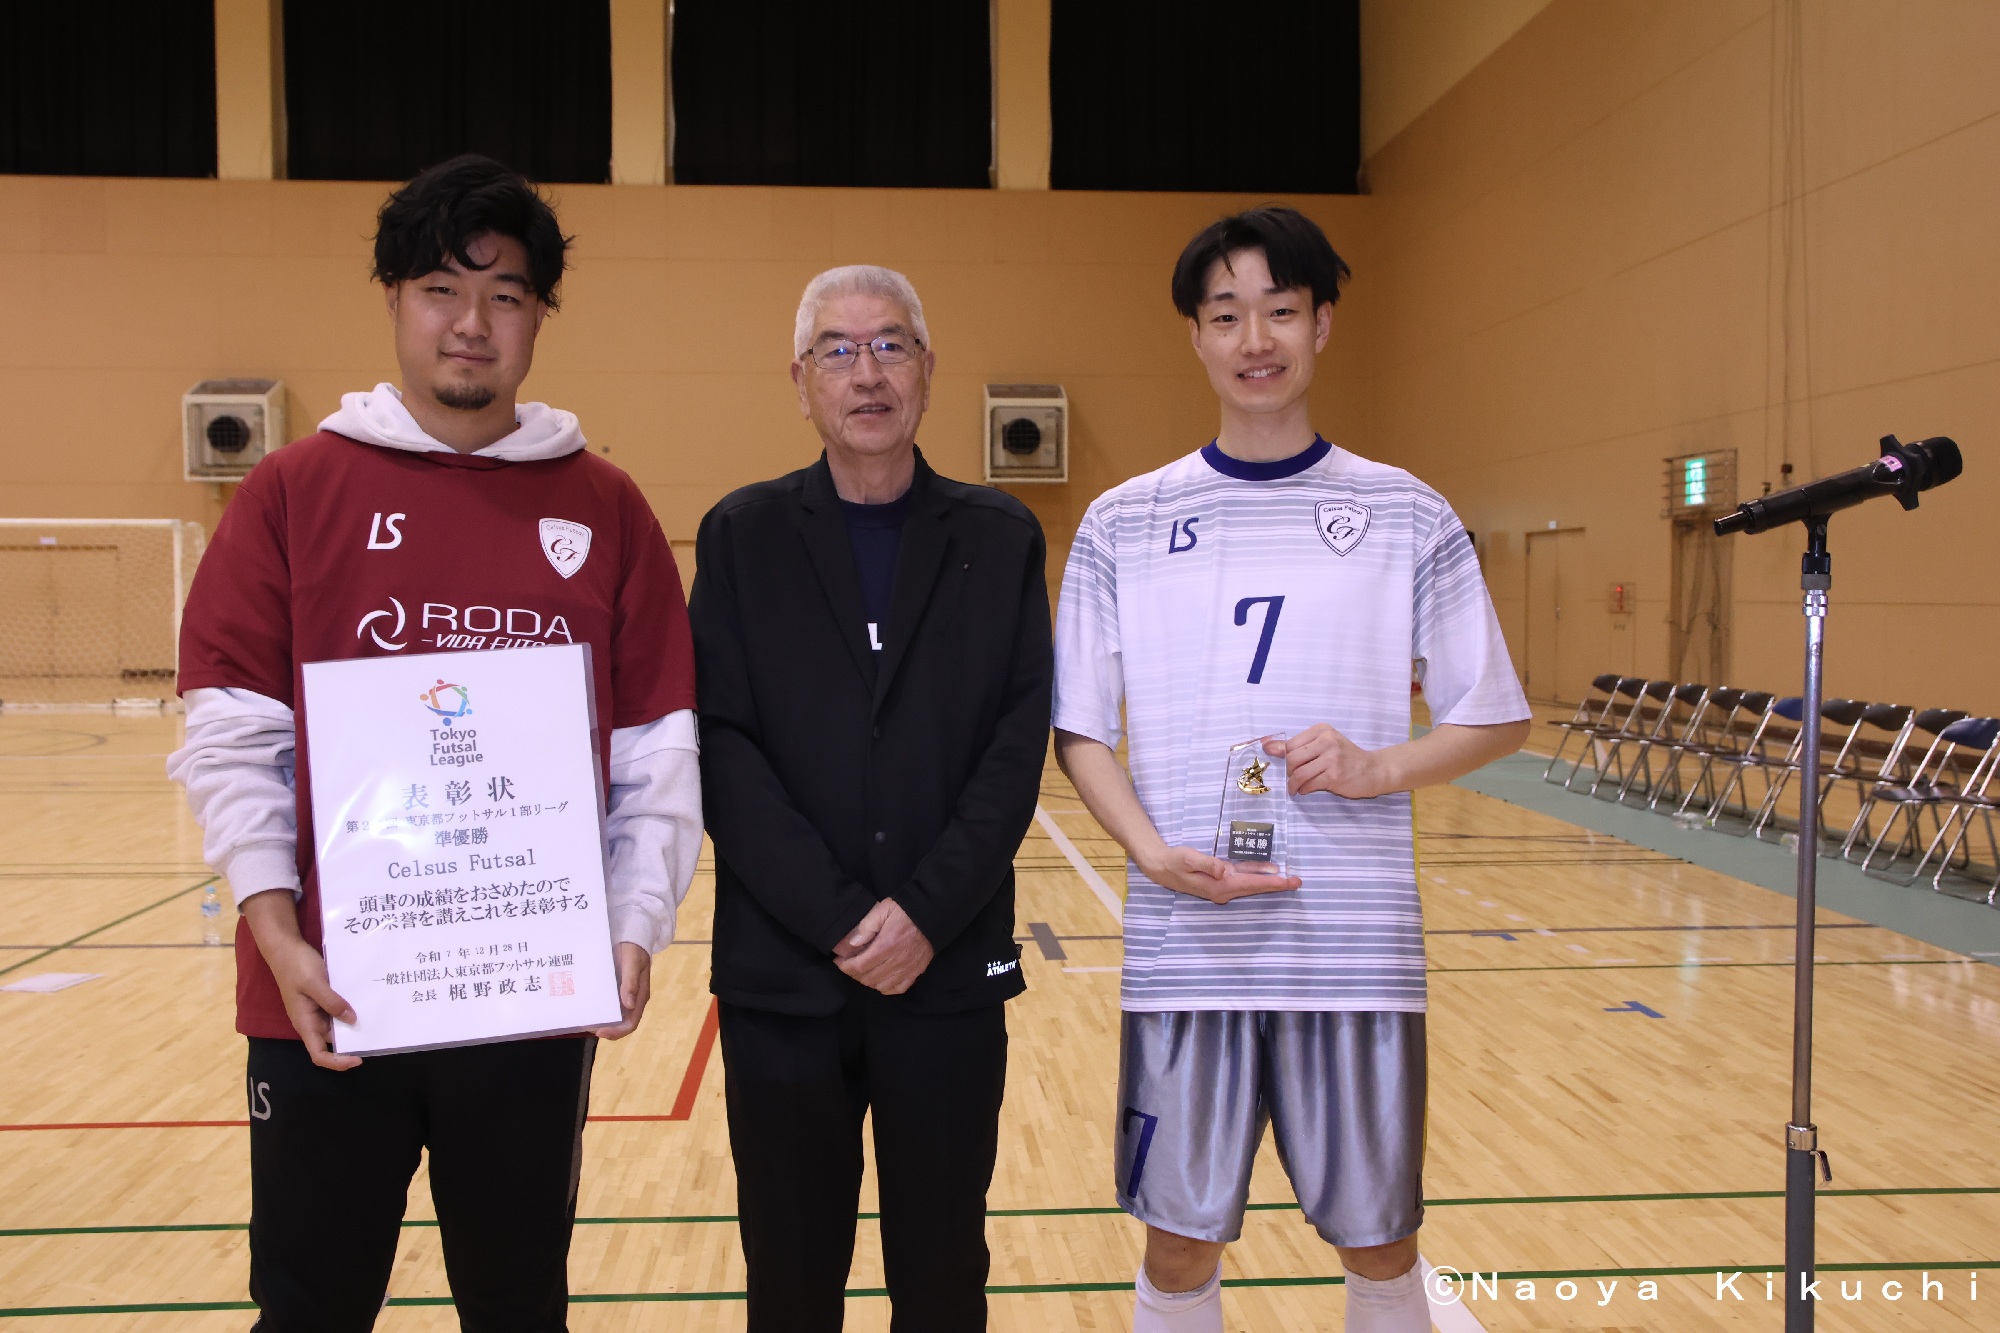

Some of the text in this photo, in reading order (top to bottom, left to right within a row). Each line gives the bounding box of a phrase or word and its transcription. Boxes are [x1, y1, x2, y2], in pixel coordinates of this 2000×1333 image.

[367, 512, 406, 549] LS
[1168, 517, 1199, 554] LS
[422, 602, 574, 644] RODA
[1234, 595, 1286, 684] 7
[430, 728, 477, 742] Tokyo
[433, 739, 477, 754] Futsal
[430, 753, 484, 767] League
[401, 776, 516, 811] 表彰状
[434, 826, 489, 848] 準優勝
[388, 849, 537, 879] Celsus Futsal
[359, 877, 570, 914] 頭書の成績をおさめたので
[372, 953, 575, 985] 一般社団法人東京都フットサル連盟
[250, 1076, 271, 1120] LS
[1122, 1106, 1158, 1198] 7
